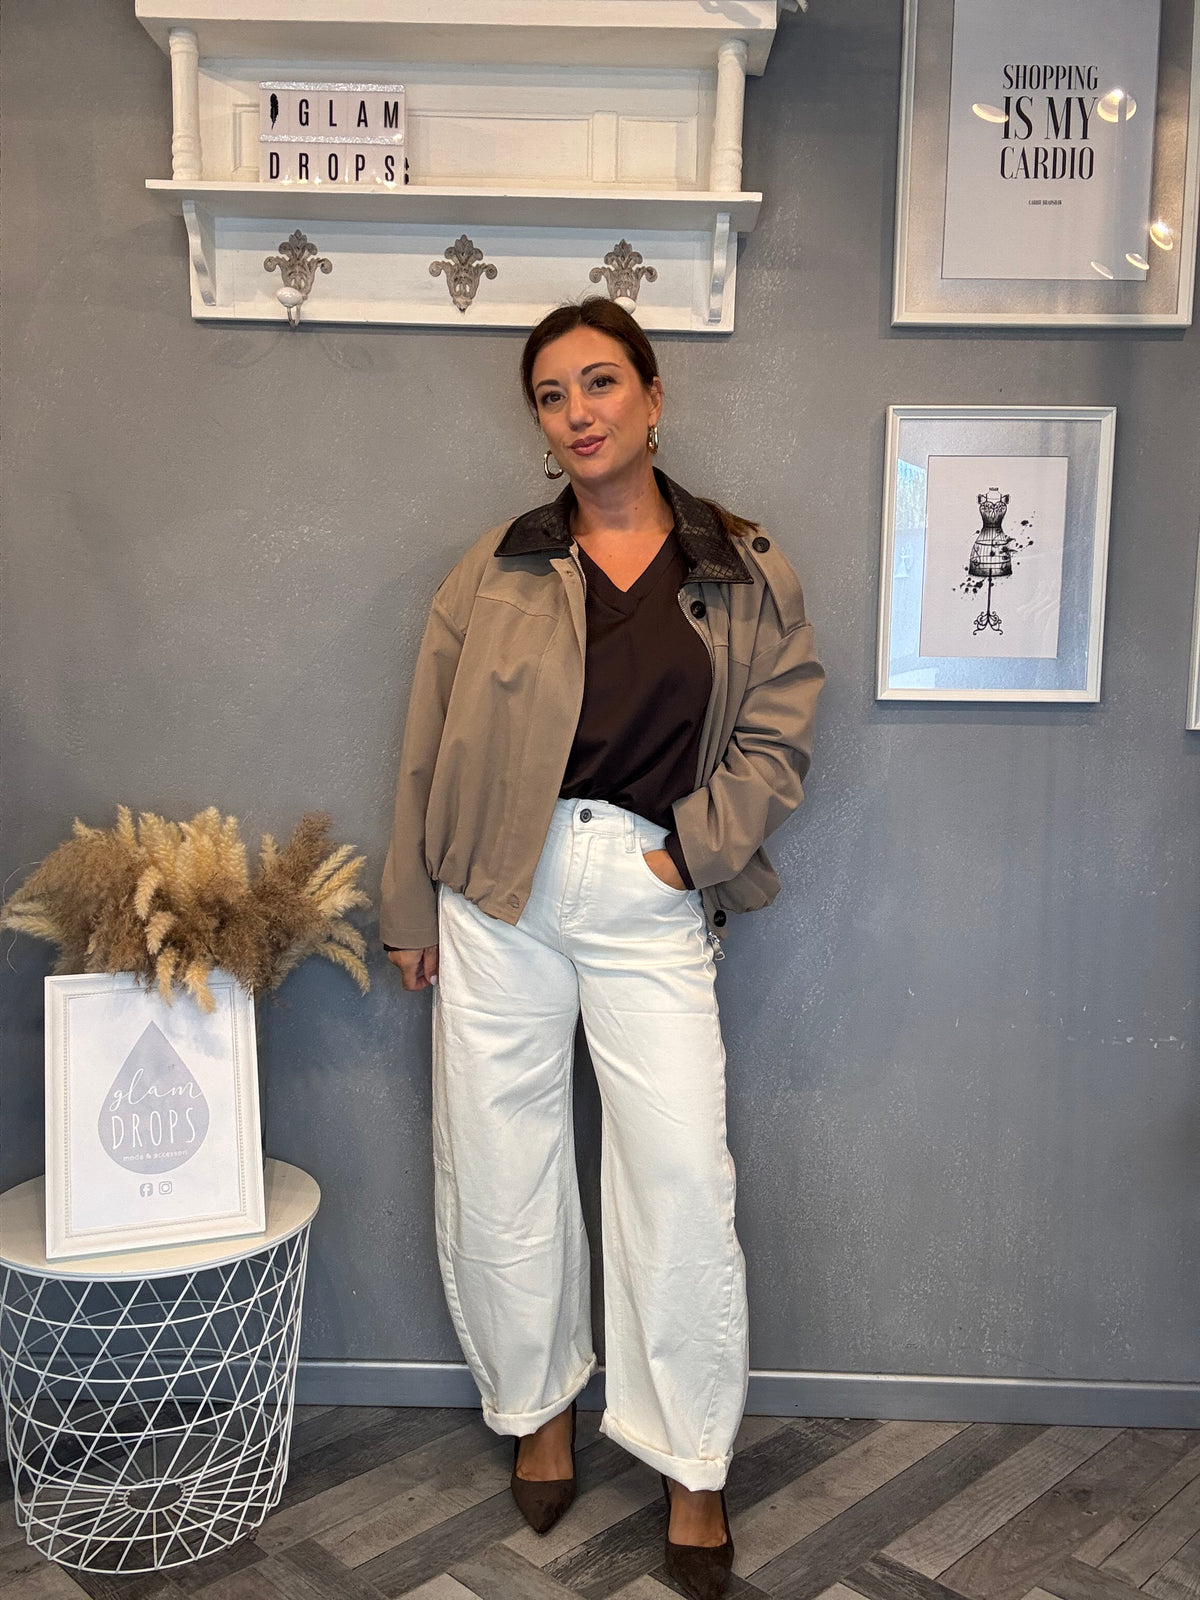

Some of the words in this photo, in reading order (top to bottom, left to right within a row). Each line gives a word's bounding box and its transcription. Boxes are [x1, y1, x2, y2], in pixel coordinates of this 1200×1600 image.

[1002, 64, 1099, 90] SHOPPING
[298, 99, 399, 129] GLAM
[1001, 96, 1034, 140] IS
[1044, 96, 1099, 140] MY
[269, 152, 395, 182] DROPS
[1000, 146, 1095, 180] CARDIO
[109, 1068, 202, 1112] glam
[111, 1107, 196, 1150] DROPS
